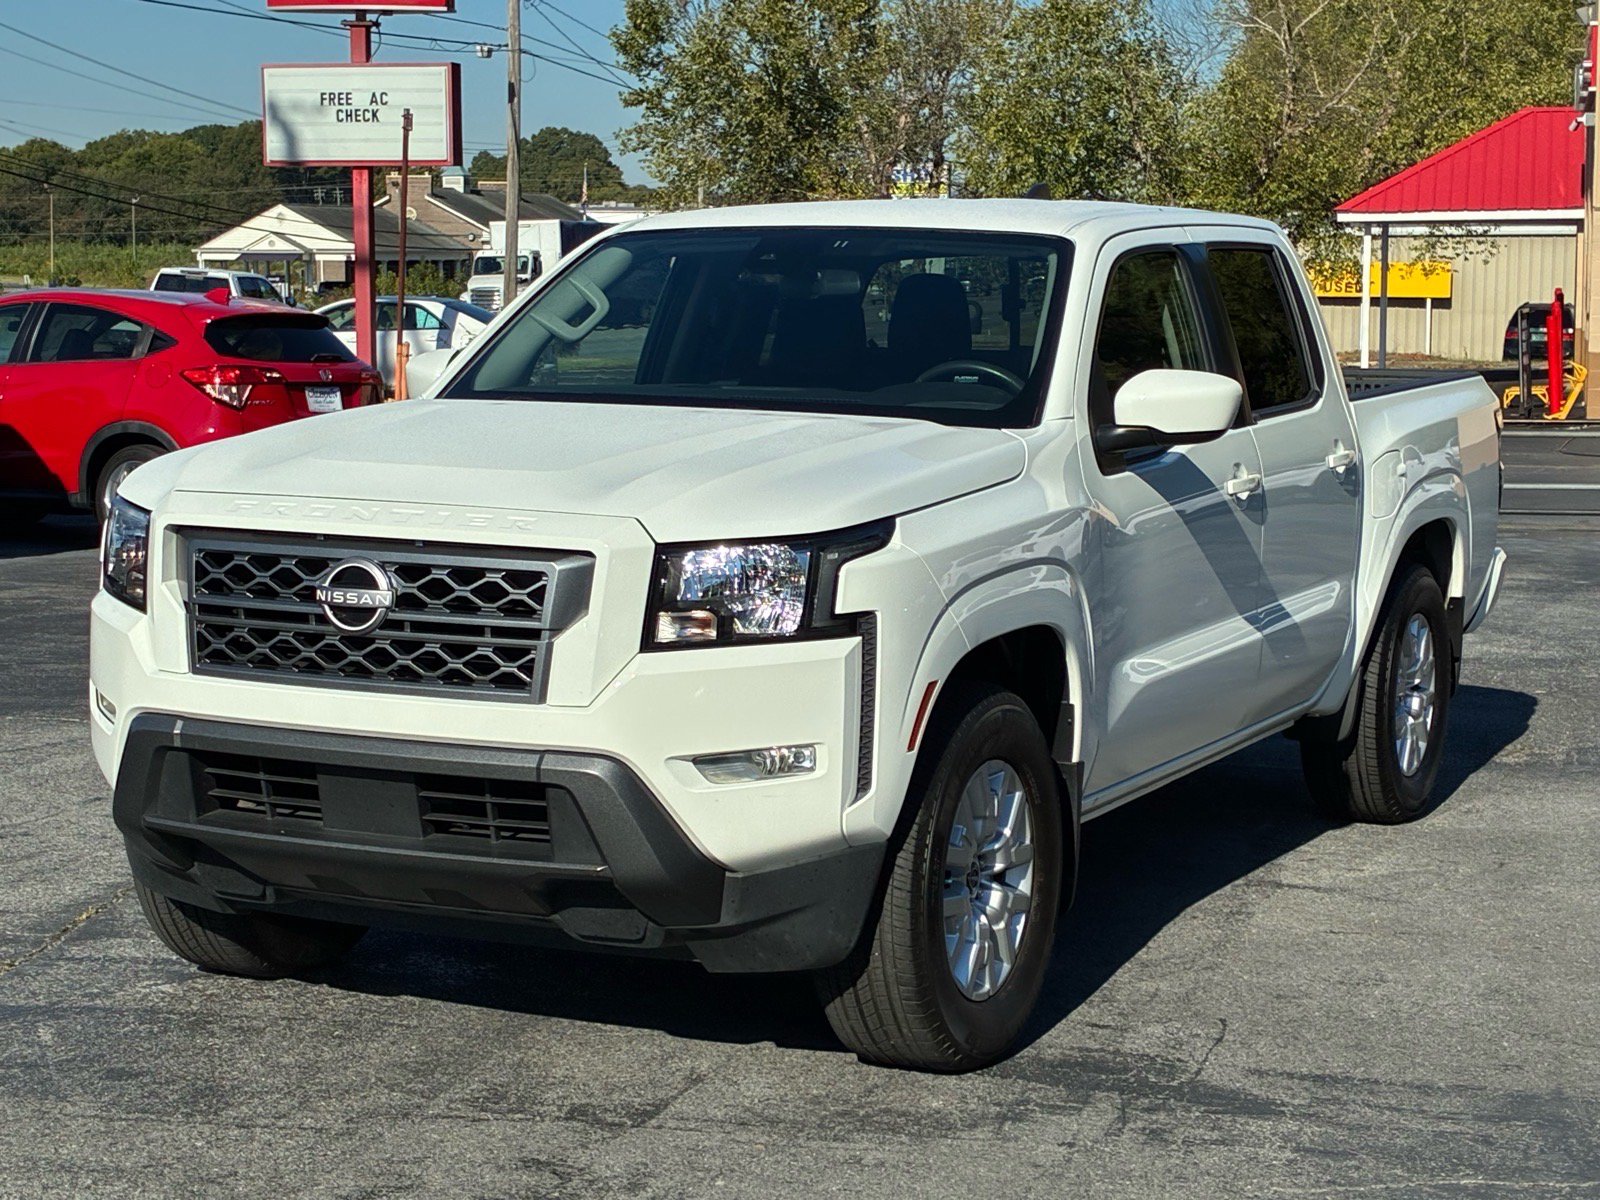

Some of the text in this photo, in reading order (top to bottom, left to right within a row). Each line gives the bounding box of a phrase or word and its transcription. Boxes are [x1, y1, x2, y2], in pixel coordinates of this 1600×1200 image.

[320, 91, 389, 106] FREE AC
[336, 108, 380, 123] CHECK
[225, 500, 538, 531] FRONTIER
[316, 589, 390, 606] NISSAN
